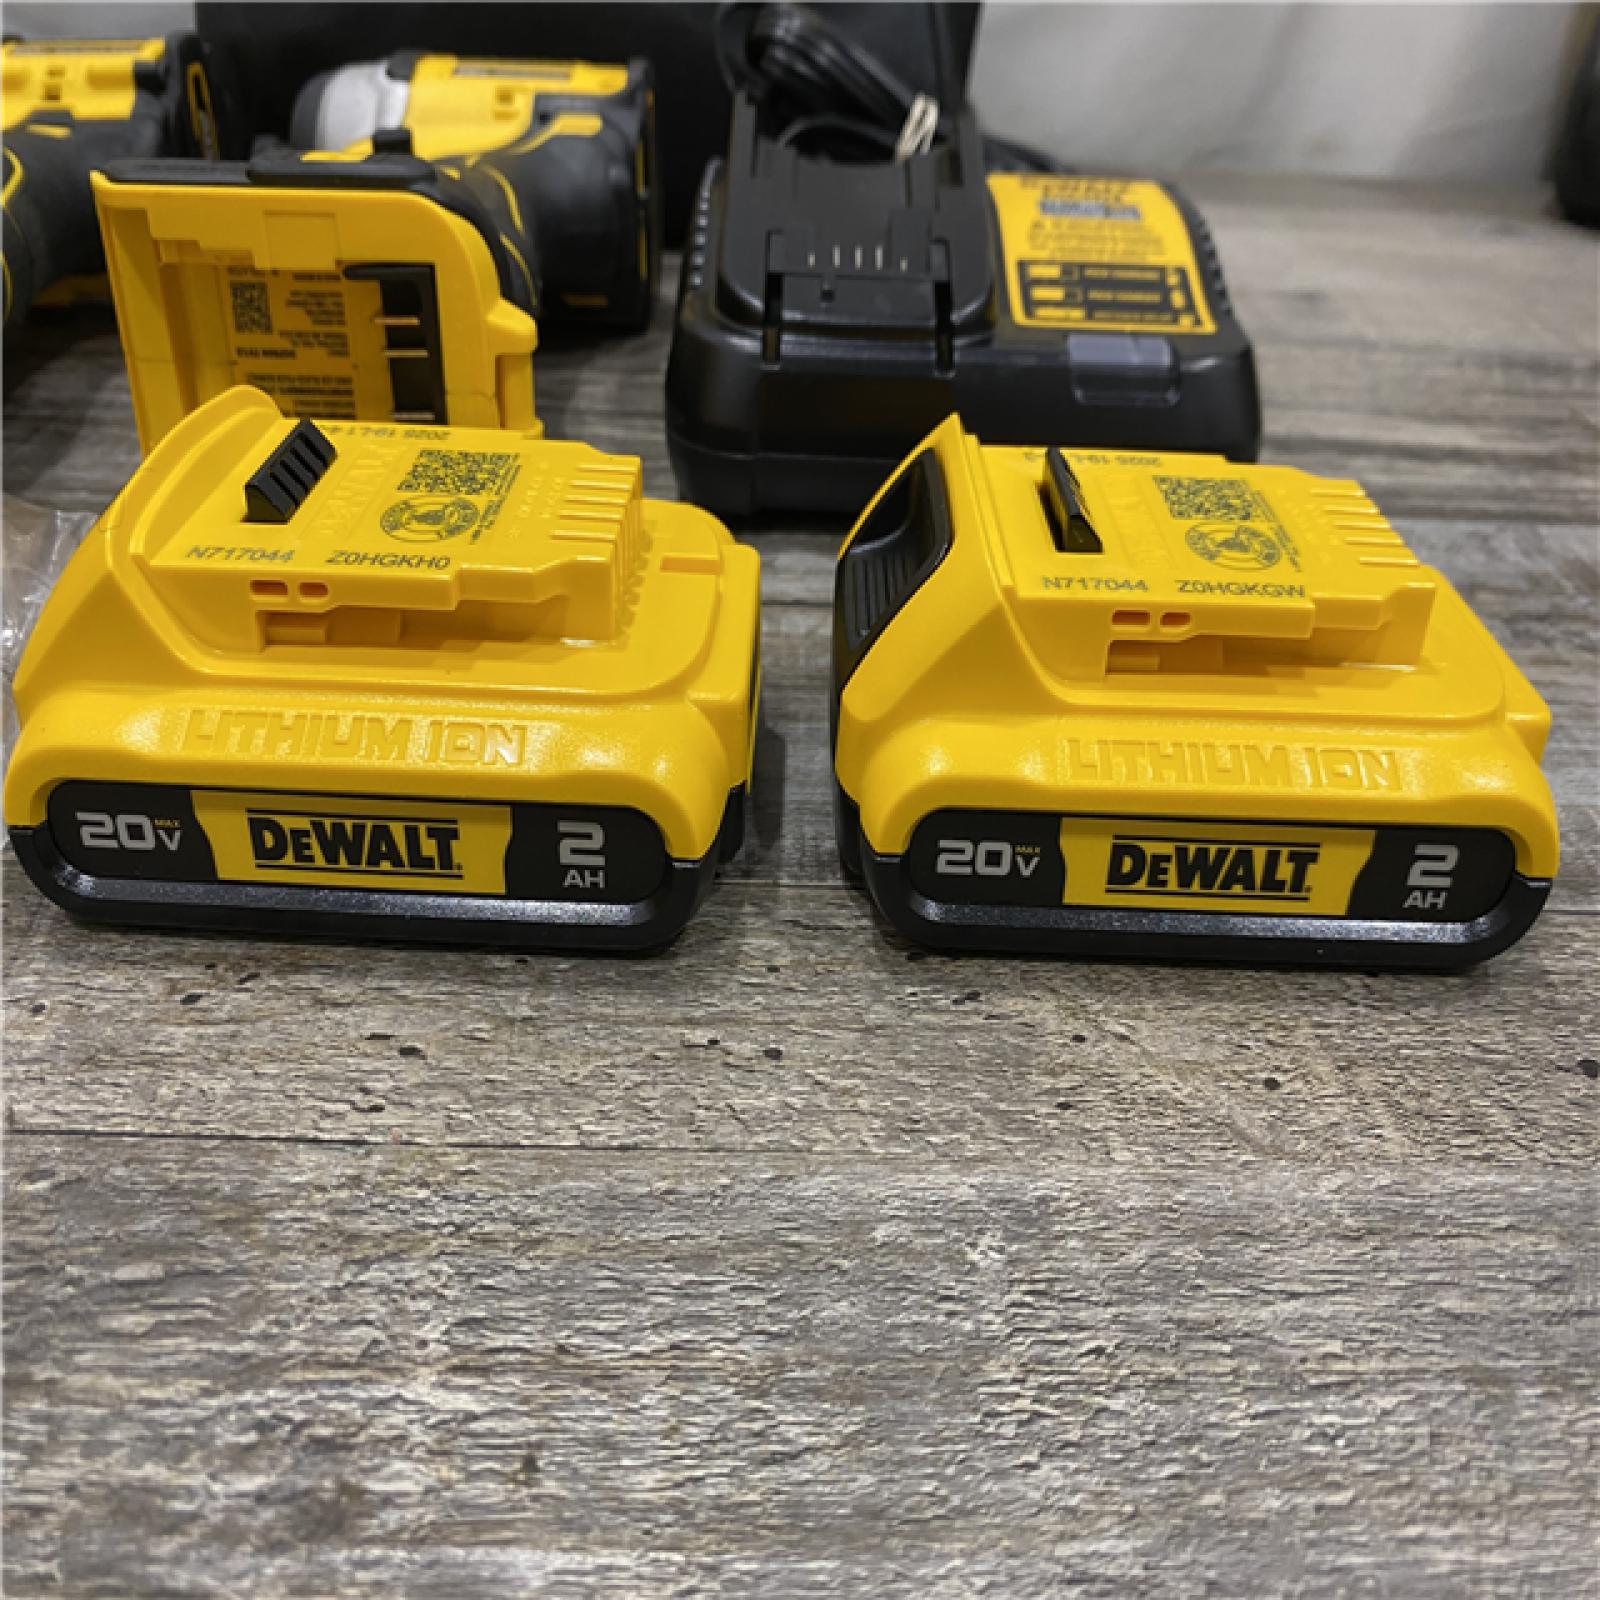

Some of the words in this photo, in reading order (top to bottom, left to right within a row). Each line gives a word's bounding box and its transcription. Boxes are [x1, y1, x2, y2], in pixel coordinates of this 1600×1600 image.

[184, 545, 295, 562] N717044
[1042, 576, 1149, 592] N717044
[180, 708, 414, 763] LITHIUM
[424, 718, 528, 766] ION
[1064, 738, 1293, 787] LITHIUM
[1303, 745, 1403, 791] ION
[557, 819, 606, 866] 2
[563, 868, 606, 889] AH
[1406, 844, 1459, 888] 2
[1401, 889, 1448, 909] AH
